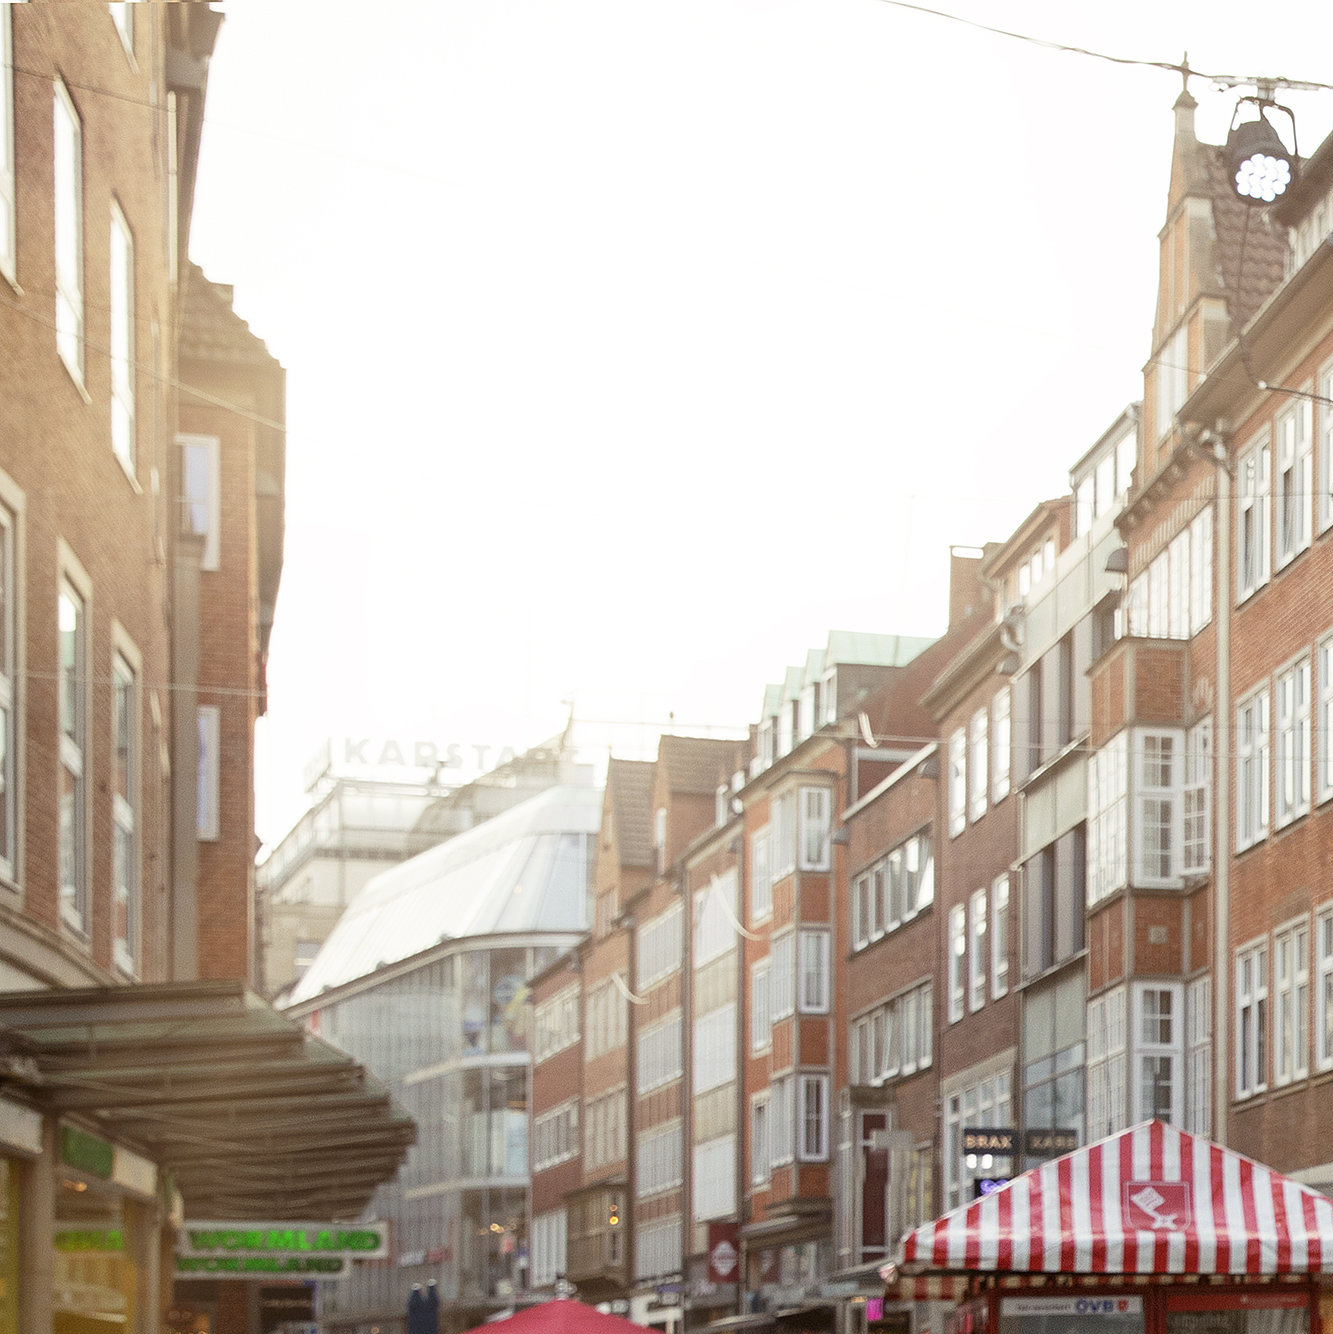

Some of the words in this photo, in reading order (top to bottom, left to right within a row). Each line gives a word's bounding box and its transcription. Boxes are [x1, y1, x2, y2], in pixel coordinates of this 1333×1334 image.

[344, 737, 580, 771] KARSTA
[966, 1135, 1013, 1149] BRAX
[188, 1230, 380, 1250] WORMLAND
